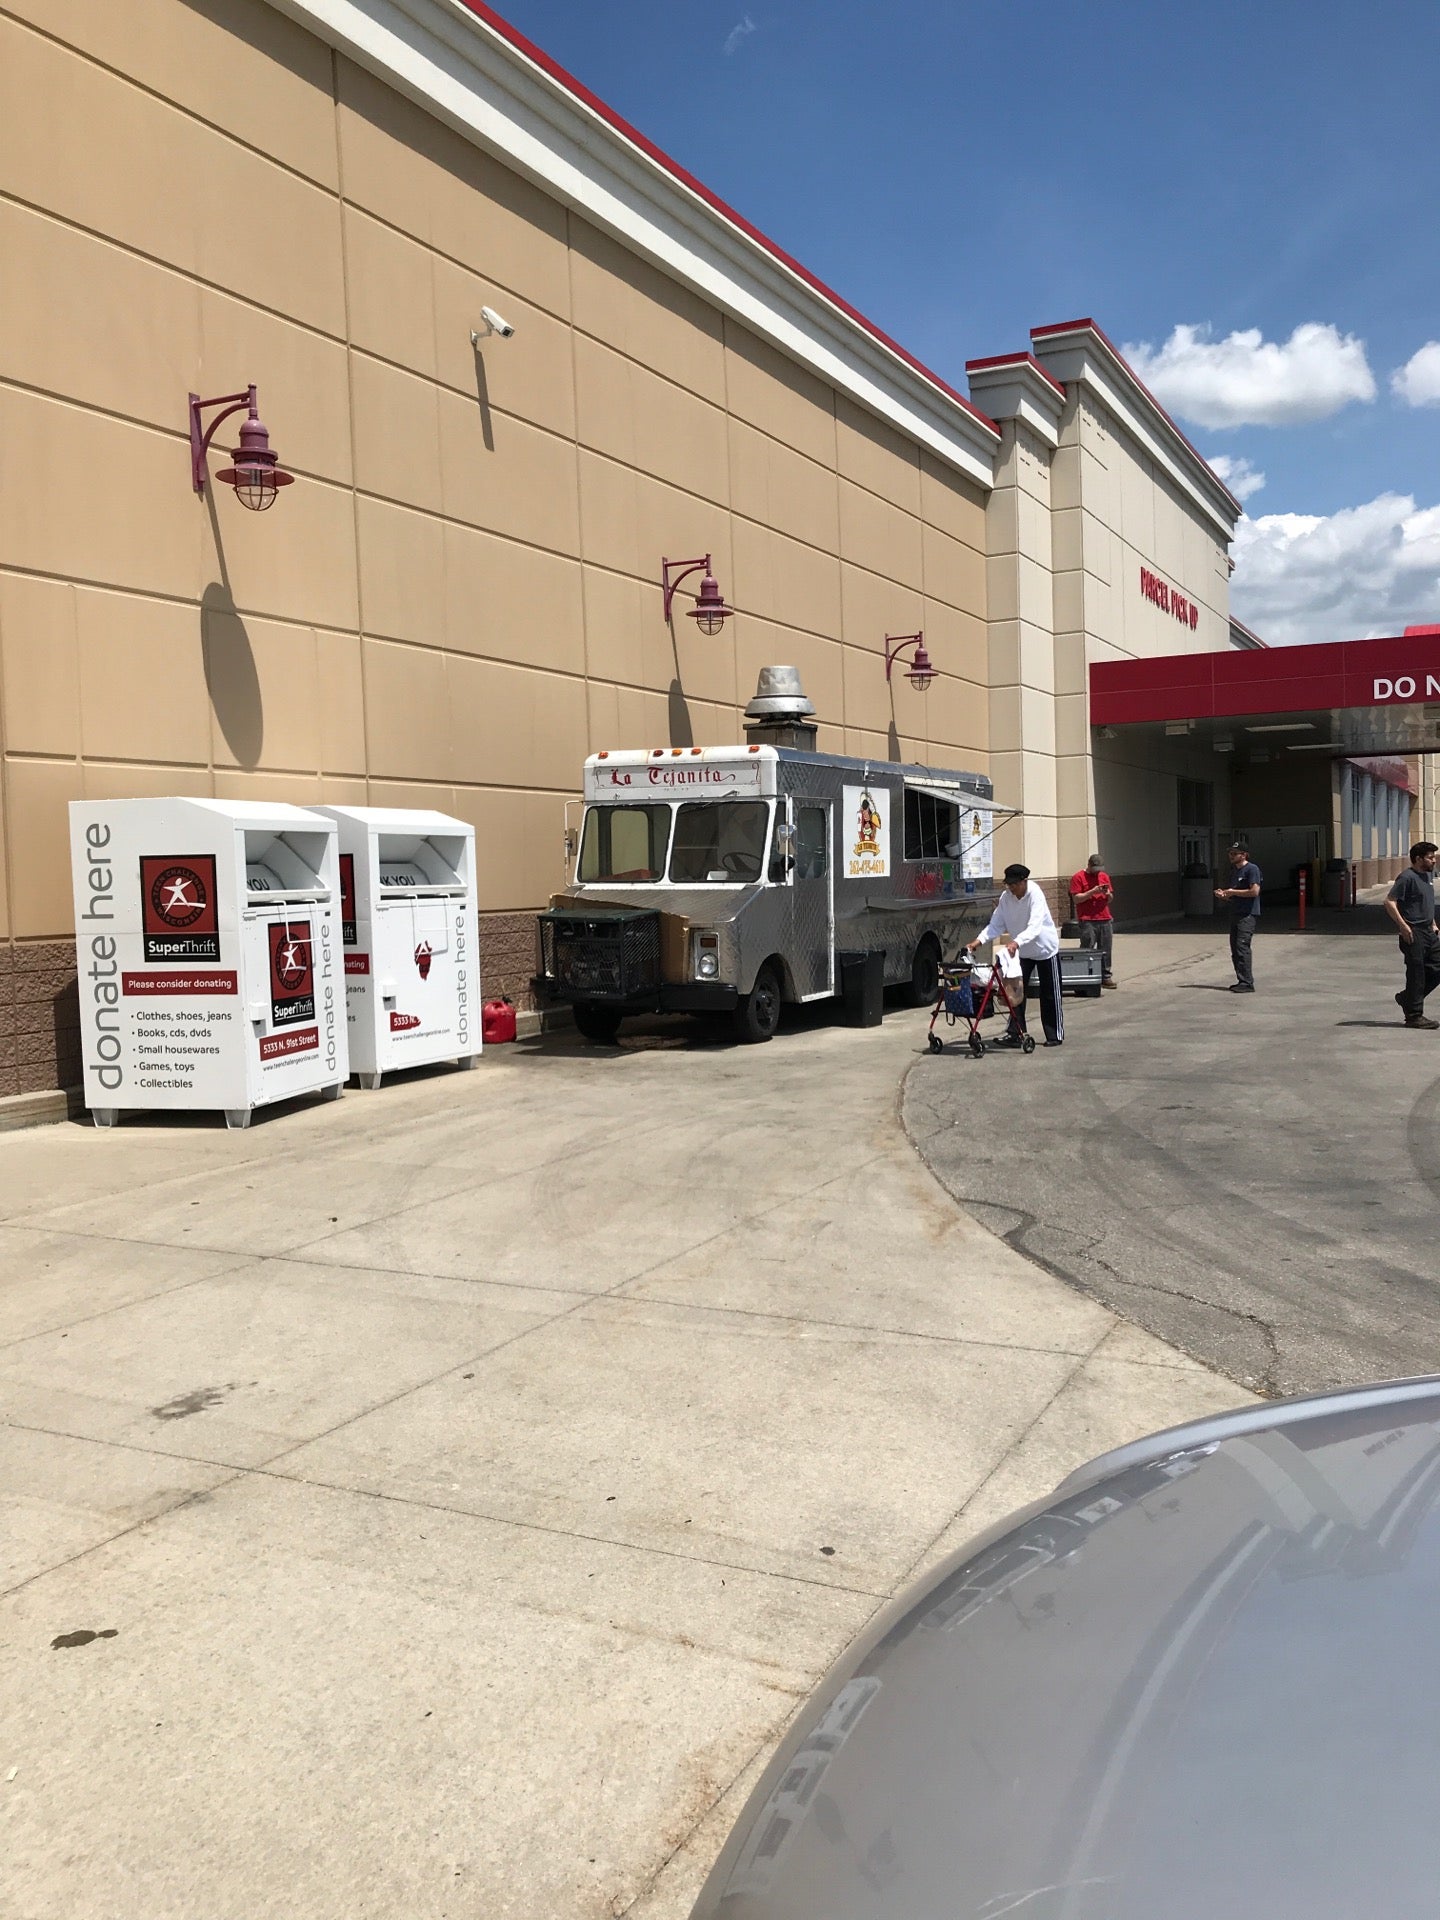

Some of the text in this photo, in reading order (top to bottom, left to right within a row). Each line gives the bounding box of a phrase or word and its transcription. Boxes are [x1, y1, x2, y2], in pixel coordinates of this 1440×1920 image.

[1140, 566, 1198, 632] PARCEL PICK UP
[1373, 676, 1416, 699] DO
[611, 768, 632, 786] La
[391, 875, 416, 886] YOU
[148, 940, 216, 956] SuperThrift
[82, 823, 123, 1090] donate here
[128, 979, 232, 989] Please consider donating
[455, 917, 468, 1044] donate here
[322, 924, 336, 1071] donate here
[136, 1011, 232, 1022] Clothes, shoes, jeans
[275, 1000, 313, 1018] SuperThrift
[137, 1028, 212, 1038] Books, cds, dvds
[138, 1045, 220, 1054] Small housewares
[139, 1061, 195, 1072] Games, toys
[140, 1078, 193, 1088] Collectibles
